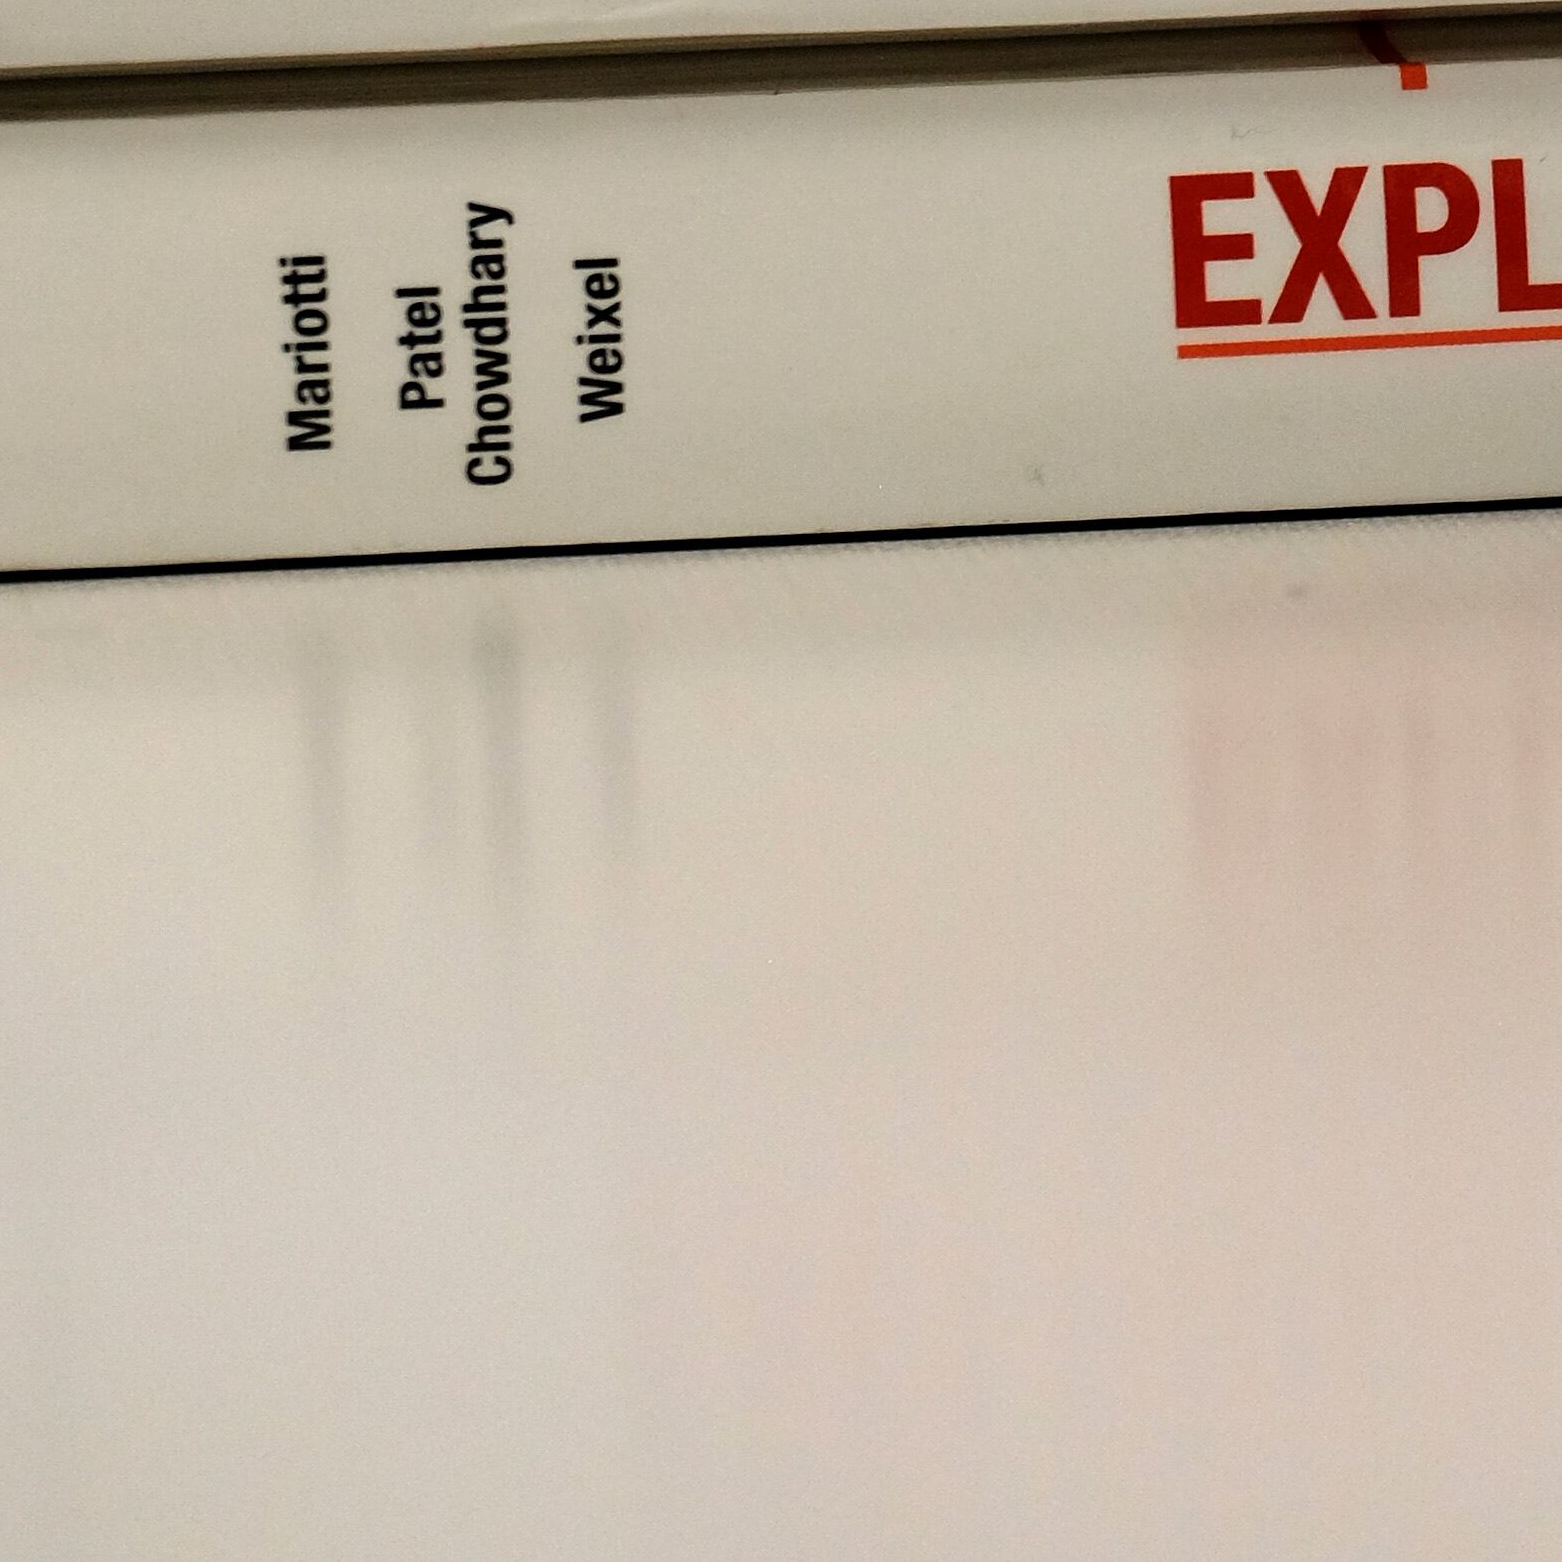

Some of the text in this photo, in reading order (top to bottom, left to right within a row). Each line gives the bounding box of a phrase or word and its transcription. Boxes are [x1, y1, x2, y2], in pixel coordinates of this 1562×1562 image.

[279, 255, 333, 452] Mariotti
[395, 286, 445, 410] Patel
[462, 201, 515, 486] Chowdhary
[574, 256, 628, 423] Weixel
